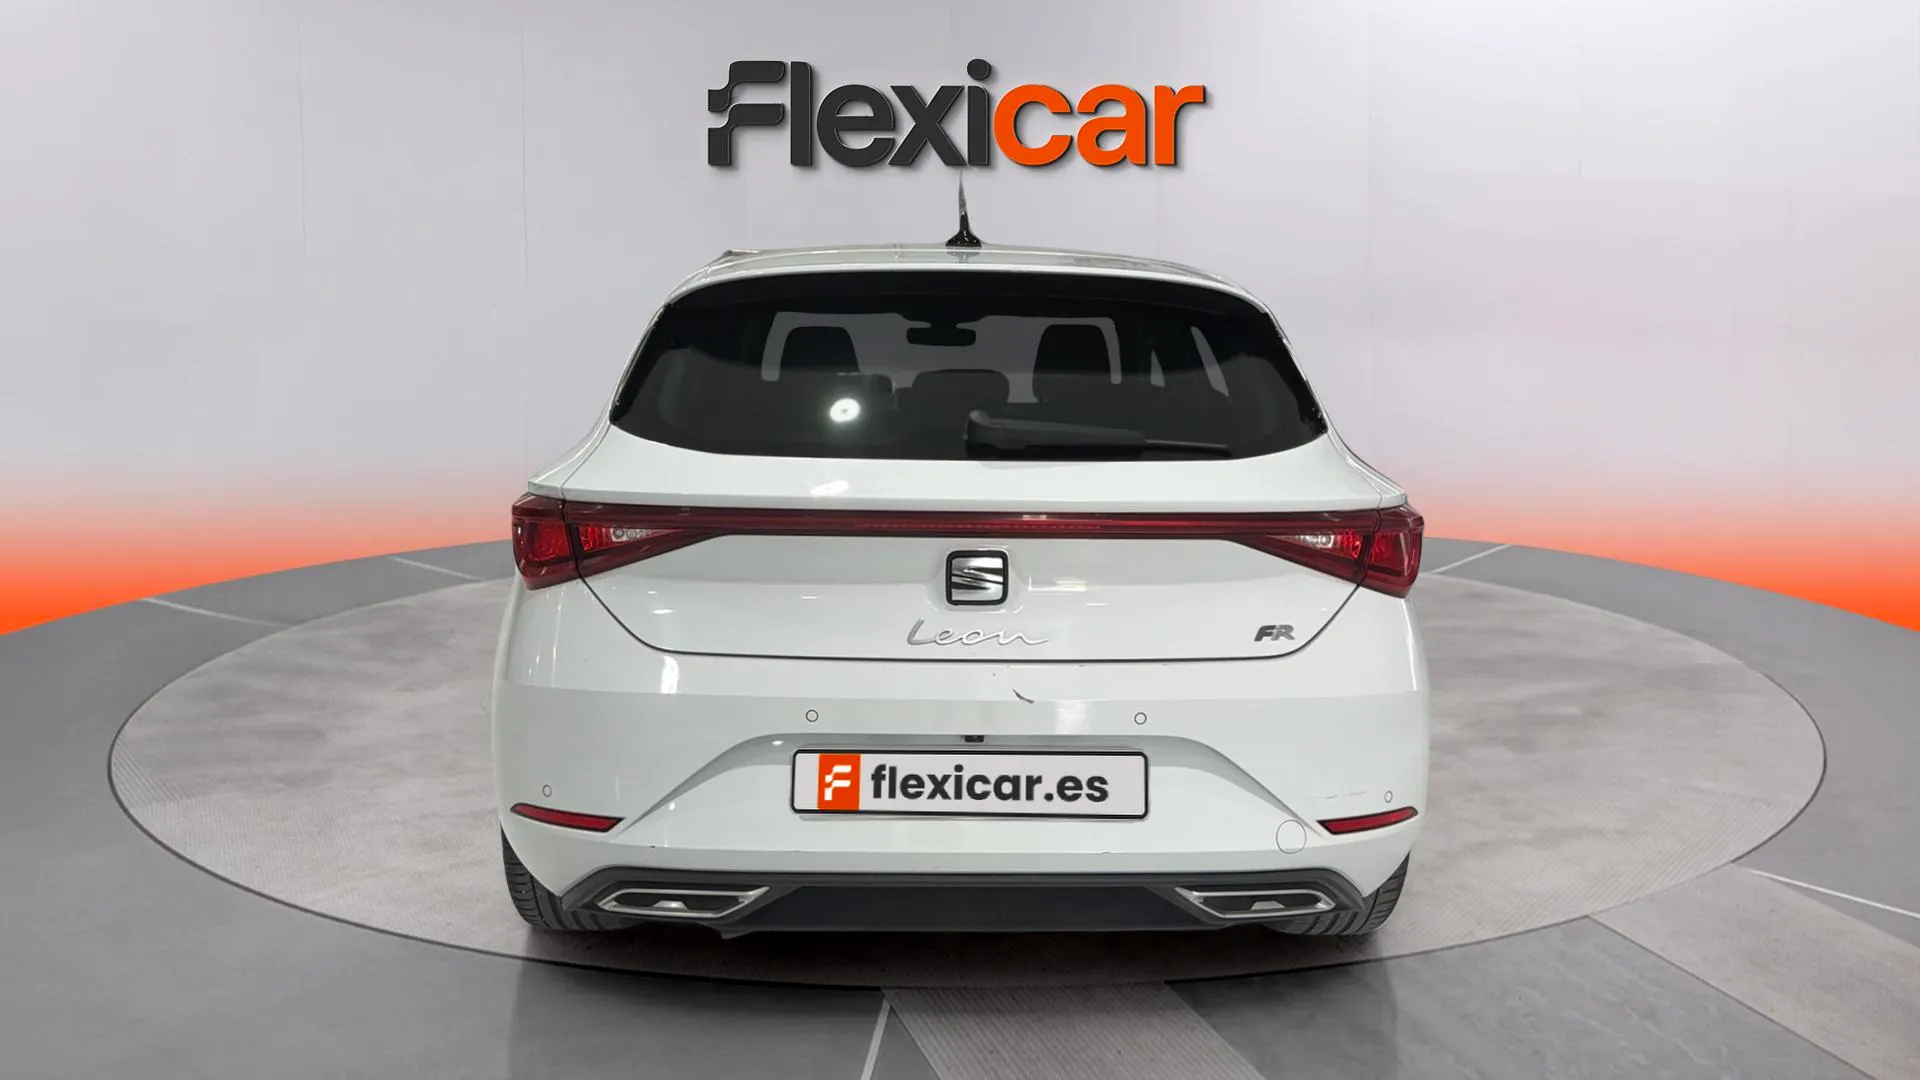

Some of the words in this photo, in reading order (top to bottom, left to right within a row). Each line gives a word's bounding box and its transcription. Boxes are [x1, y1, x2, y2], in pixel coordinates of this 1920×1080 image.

[707, 58, 1206, 167] Flexicar
[907, 618, 1049, 646] Leon
[1254, 624, 1295, 642] FR
[871, 763, 1109, 803] flexicar.es
